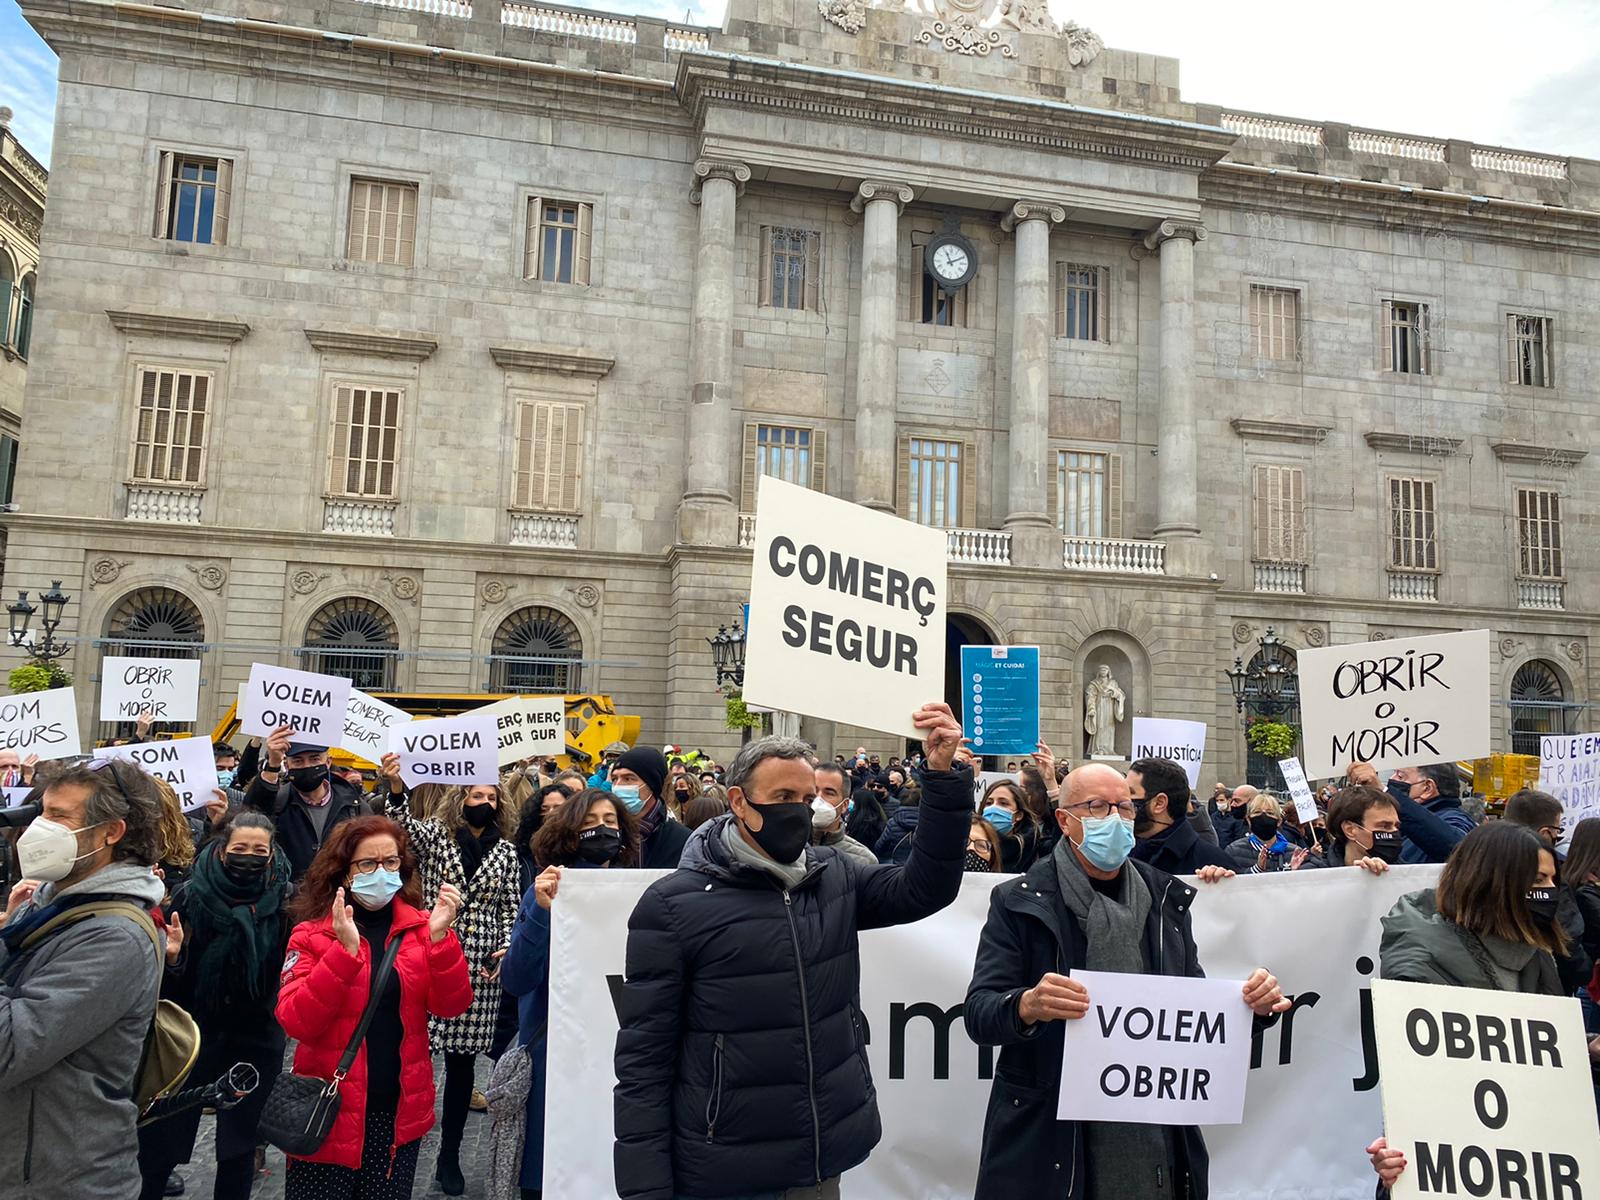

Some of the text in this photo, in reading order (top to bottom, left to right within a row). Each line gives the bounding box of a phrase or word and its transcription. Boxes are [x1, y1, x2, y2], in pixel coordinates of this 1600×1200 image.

[769, 535, 936, 627] COMERÇ
[782, 604, 918, 676] SEGUR
[0, 699, 41, 722] OM
[262, 680, 331, 707] VOLEM
[261, 710, 321, 734] OBRIR
[130, 746, 179, 765] SOM
[404, 732, 481, 753] VOLEM
[412, 761, 476, 776] OBRIR
[1096, 1004, 1227, 1044] VOLEM
[1406, 1008, 1563, 1068] OBRIR
[1100, 1063, 1211, 1100] OBRIR
[1474, 1079, 1509, 1130] O
[1414, 1141, 1583, 1200] MORIR
